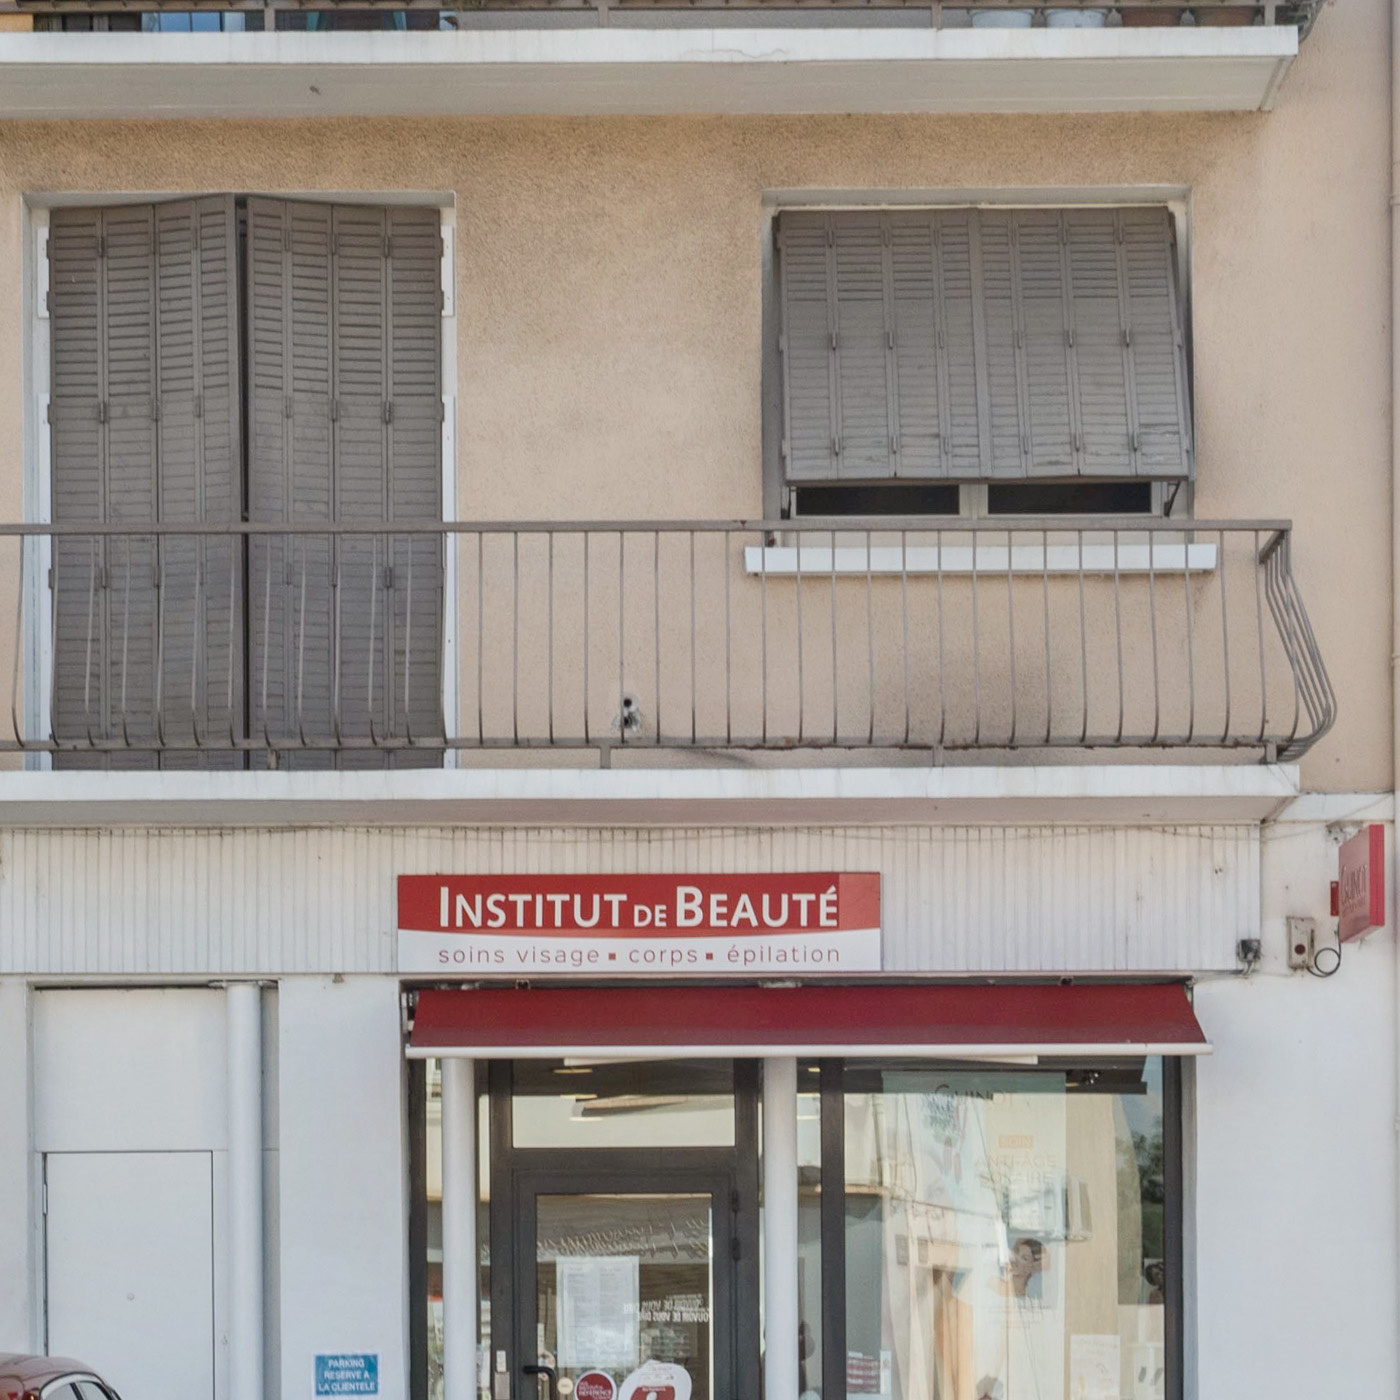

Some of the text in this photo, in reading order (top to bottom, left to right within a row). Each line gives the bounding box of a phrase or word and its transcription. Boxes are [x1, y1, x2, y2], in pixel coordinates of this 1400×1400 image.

[439, 885, 839, 928] INSTITUT DE BEAUTÉ
[438, 943, 841, 967] soins visage corps épilation
[328, 1358, 365, 1369] PARKING
[323, 1370, 370, 1380] RESERVE A
[318, 1381, 376, 1392] LA CLIENTELE
